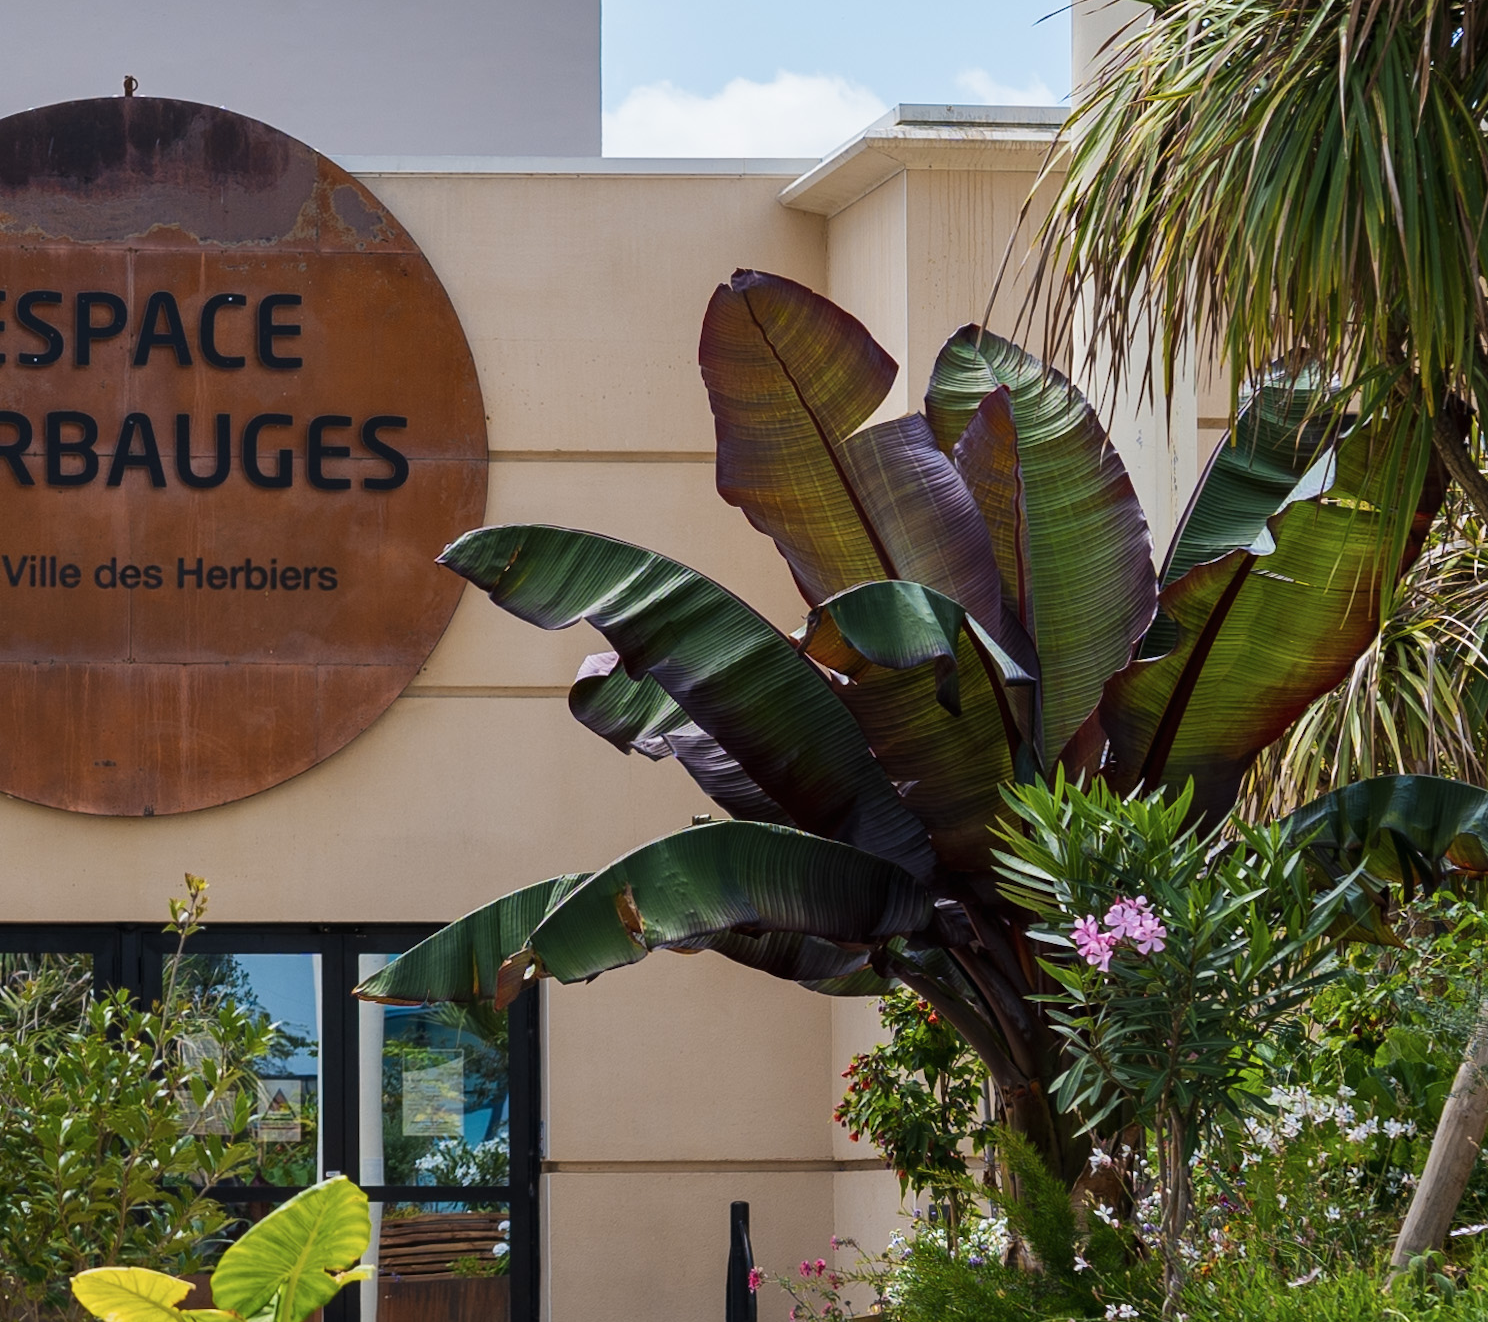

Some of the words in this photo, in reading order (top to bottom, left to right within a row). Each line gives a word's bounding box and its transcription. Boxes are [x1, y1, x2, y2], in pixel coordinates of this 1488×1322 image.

[1, 555, 82, 588] Ville
[93, 556, 164, 590] des
[176, 557, 339, 591] Herbiers
